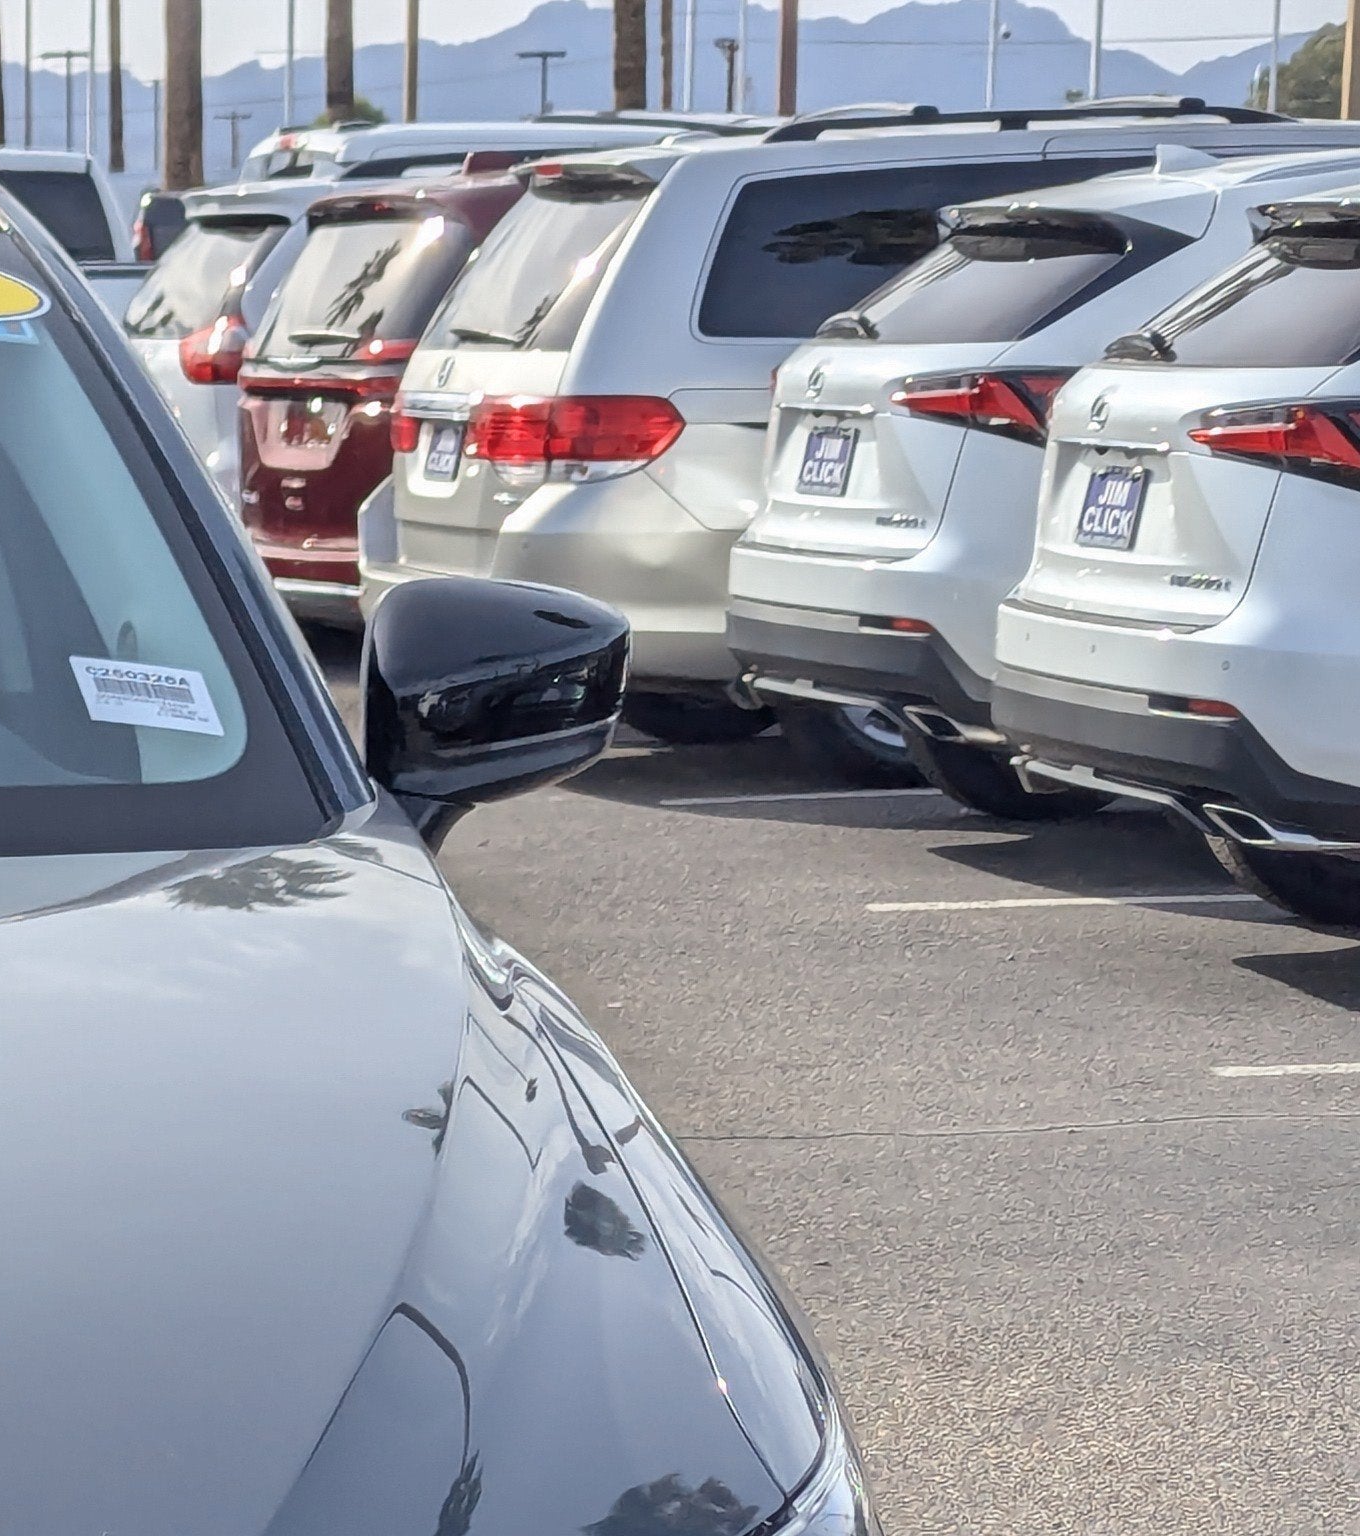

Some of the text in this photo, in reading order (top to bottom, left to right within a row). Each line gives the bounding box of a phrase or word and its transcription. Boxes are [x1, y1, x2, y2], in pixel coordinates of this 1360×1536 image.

[803, 460, 845, 484] CLICK
[1098, 480, 1133, 507] JIM
[1082, 505, 1134, 536] CLICK
